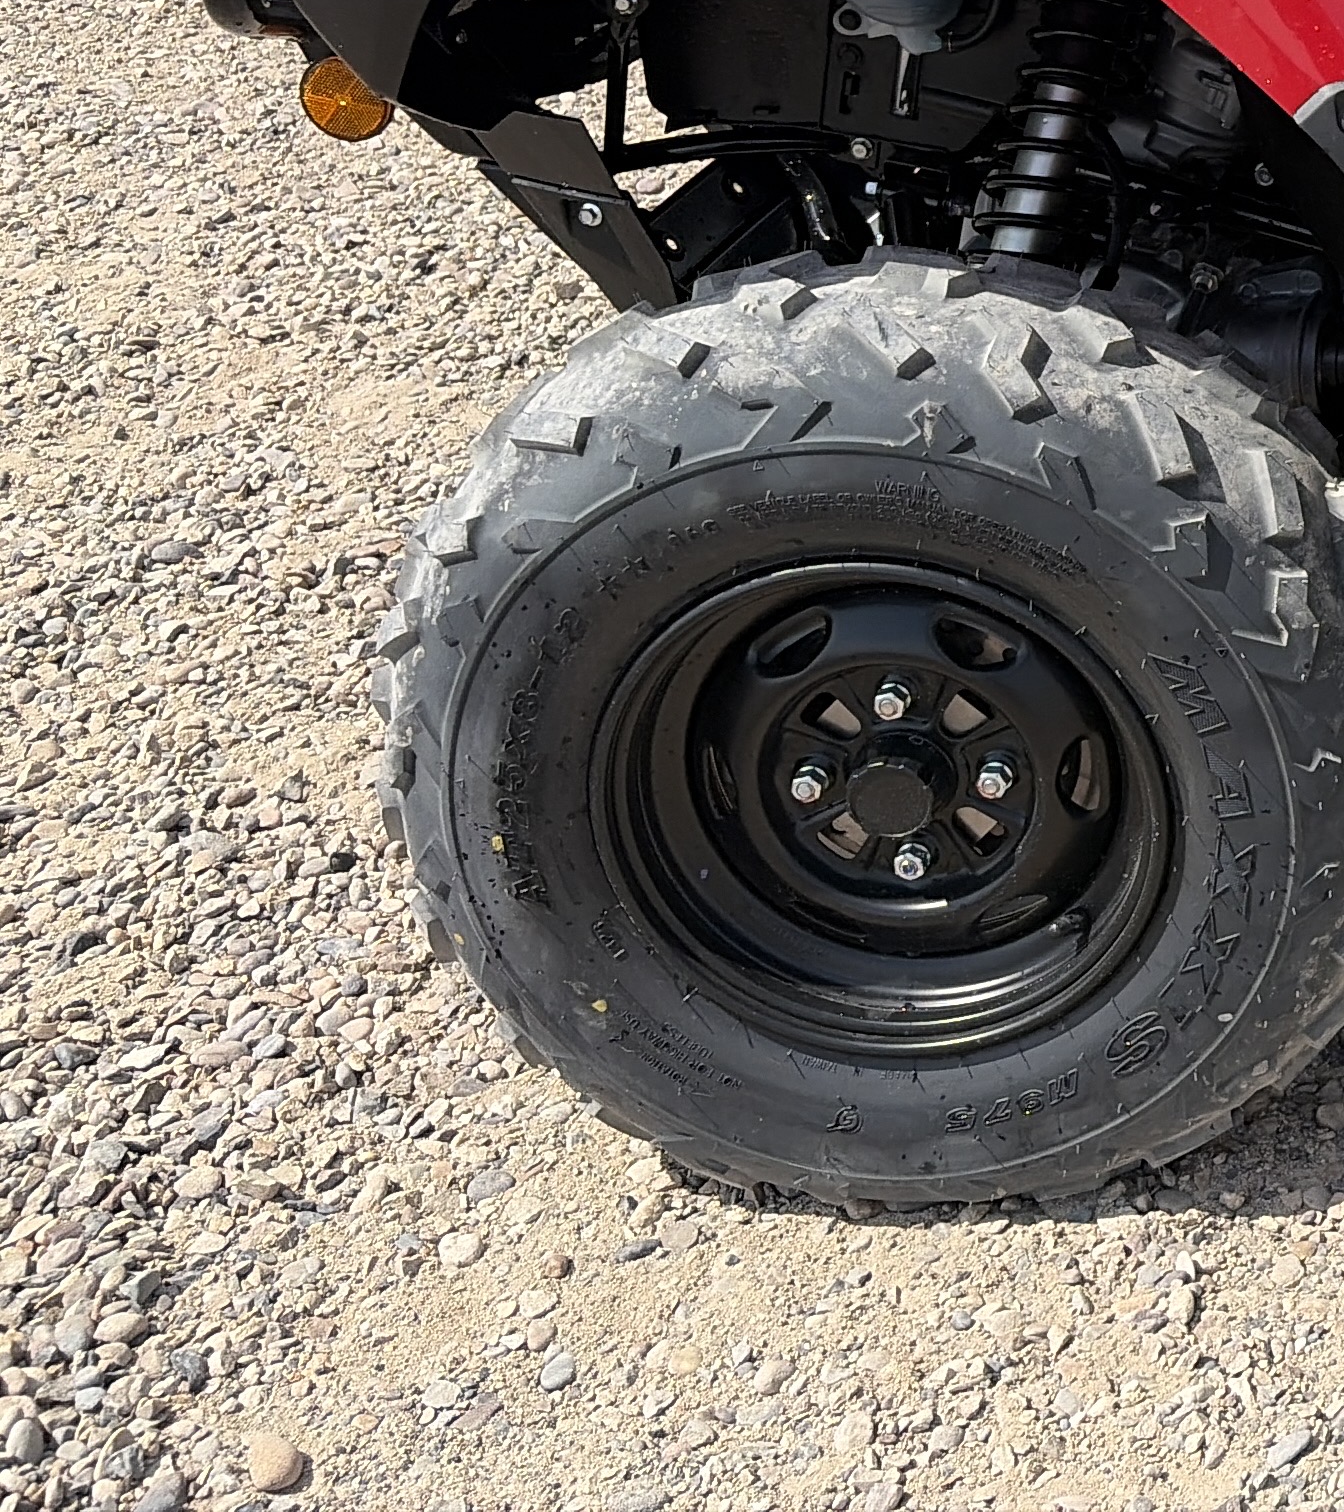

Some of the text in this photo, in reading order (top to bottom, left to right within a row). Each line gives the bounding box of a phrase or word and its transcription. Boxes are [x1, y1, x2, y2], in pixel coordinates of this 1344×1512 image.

[874, 479, 940, 502] WARNING
[1105, 652, 1252, 1078] MAXXIS
[945, 1068, 1079, 1133] M975
